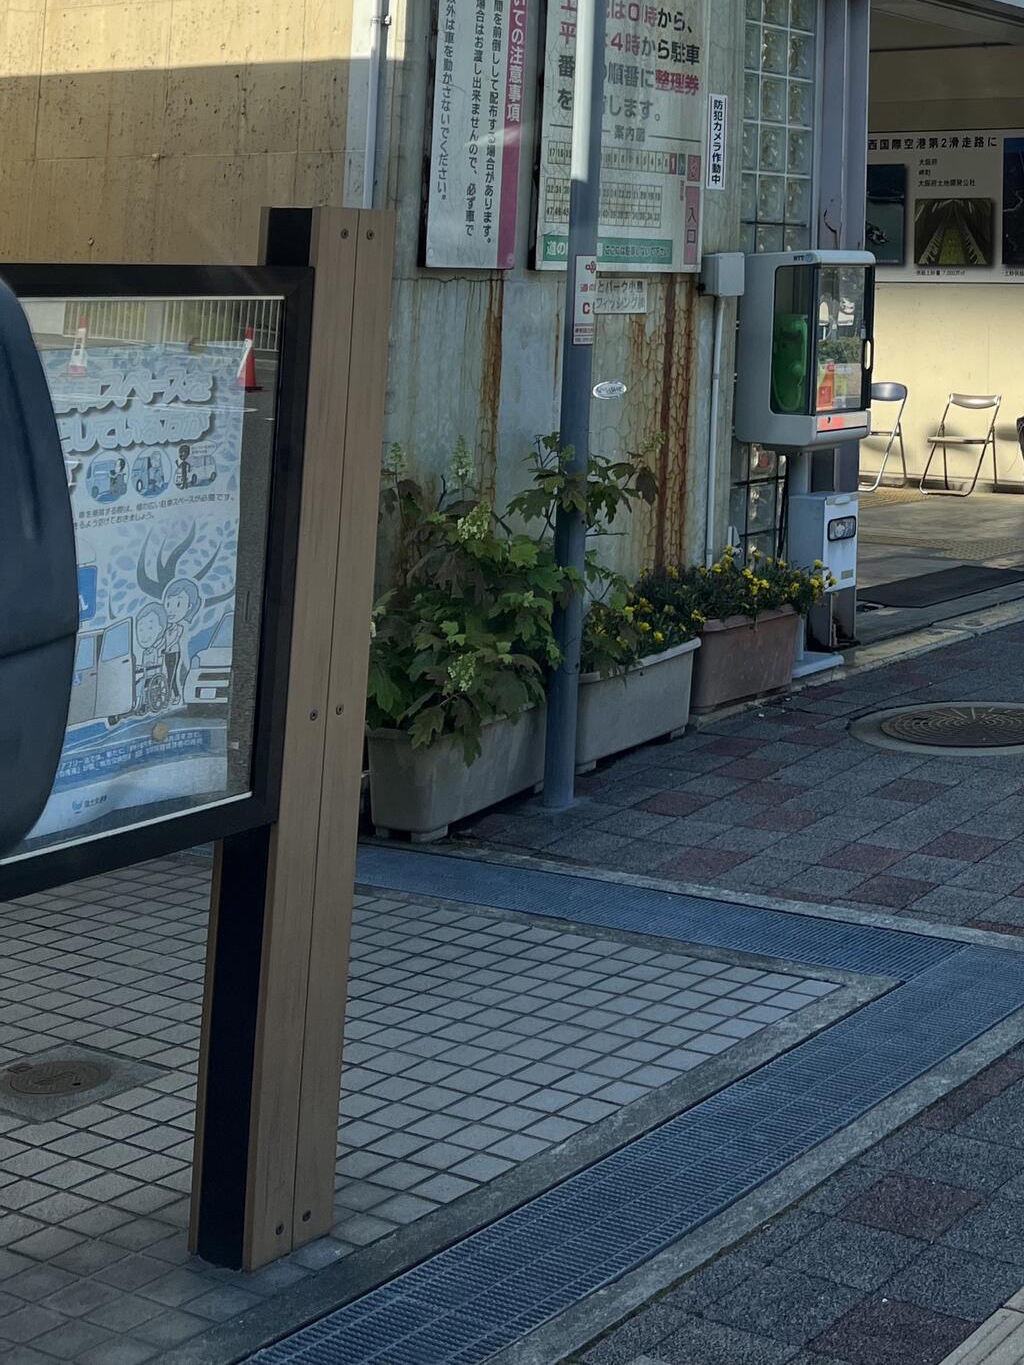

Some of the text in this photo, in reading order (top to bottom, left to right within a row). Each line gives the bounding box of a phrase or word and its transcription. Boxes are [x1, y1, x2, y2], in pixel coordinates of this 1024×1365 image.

[712, 99, 723, 185] 防犯カメラ作動中
[686, 207, 698, 244] 入口
